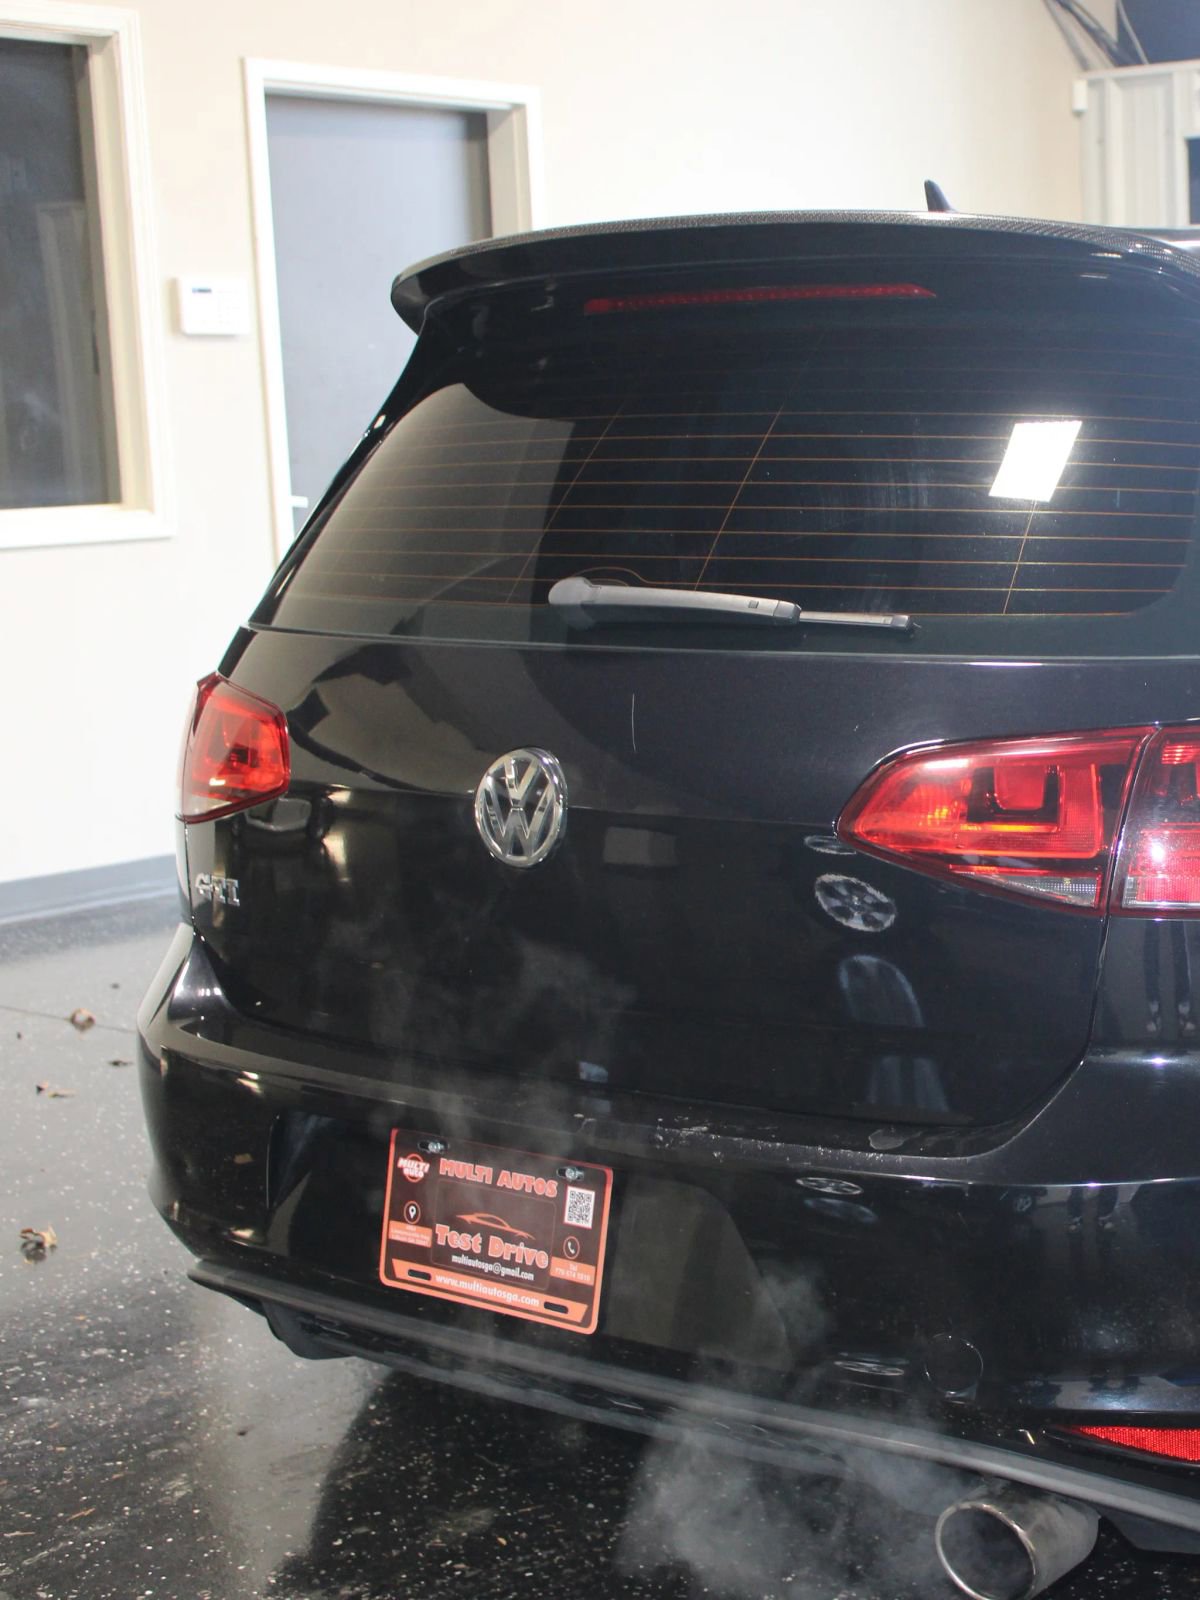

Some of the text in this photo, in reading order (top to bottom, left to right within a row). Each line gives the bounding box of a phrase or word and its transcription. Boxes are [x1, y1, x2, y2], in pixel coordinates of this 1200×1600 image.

[195, 872, 240, 906] GTI
[397, 1157, 430, 1173] MULTI
[439, 1158, 558, 1197] MULTI AUTOS
[436, 1223, 549, 1269] Test Drive
[451, 1254, 535, 1281] multiautosga@gmail.com
[435, 1274, 540, 1307] www.multiautosga.com
